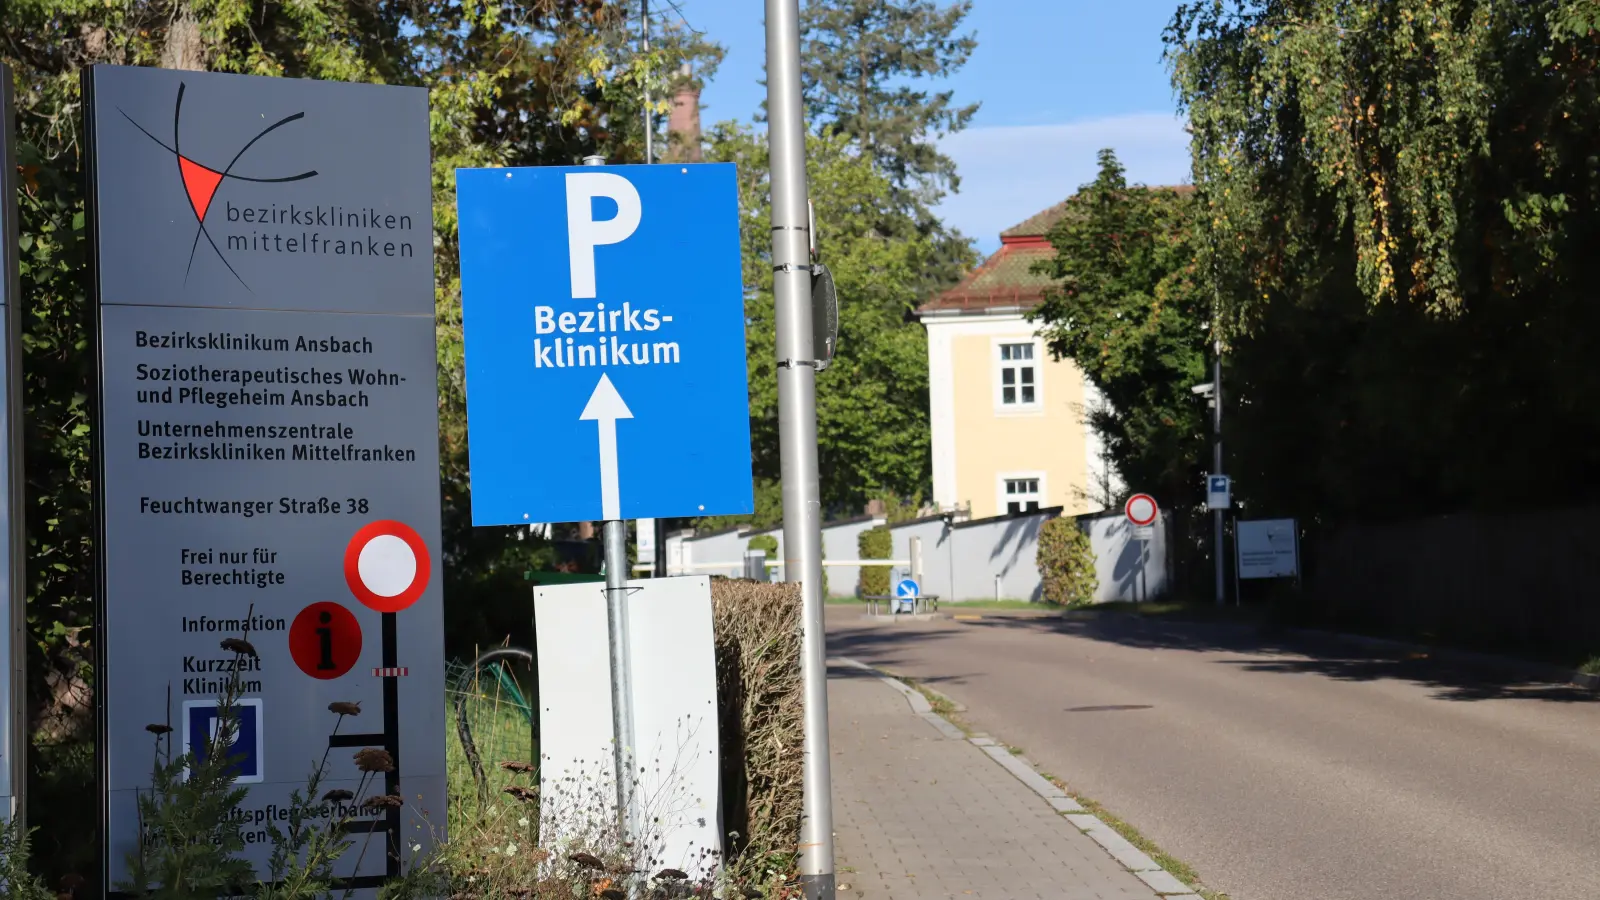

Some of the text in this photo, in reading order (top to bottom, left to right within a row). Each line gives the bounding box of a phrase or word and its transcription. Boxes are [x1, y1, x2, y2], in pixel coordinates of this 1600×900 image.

[226, 201, 412, 230] bezirkskliniken
[227, 230, 413, 258] mittelfranken
[565, 172, 642, 299] P
[534, 302, 673, 335] Bezirks-
[136, 331, 372, 353] Bezirksklinikum Ansbach
[534, 336, 680, 368] klinikum
[136, 363, 406, 387] Soziotherapeutisches Wohn-
[137, 387, 369, 409] und Pflegeheim Ansbach
[138, 420, 353, 439] Unternehmenszentrale
[138, 443, 415, 462] Bezirkskliniken Mittelfranken
[140, 497, 369, 517] Feuchtwanger Straße 38
[181, 547, 278, 564] Frei nur für
[181, 568, 285, 588] Berechtigte
[182, 615, 285, 632] Information
[183, 655, 261, 673] Kurzzeit
